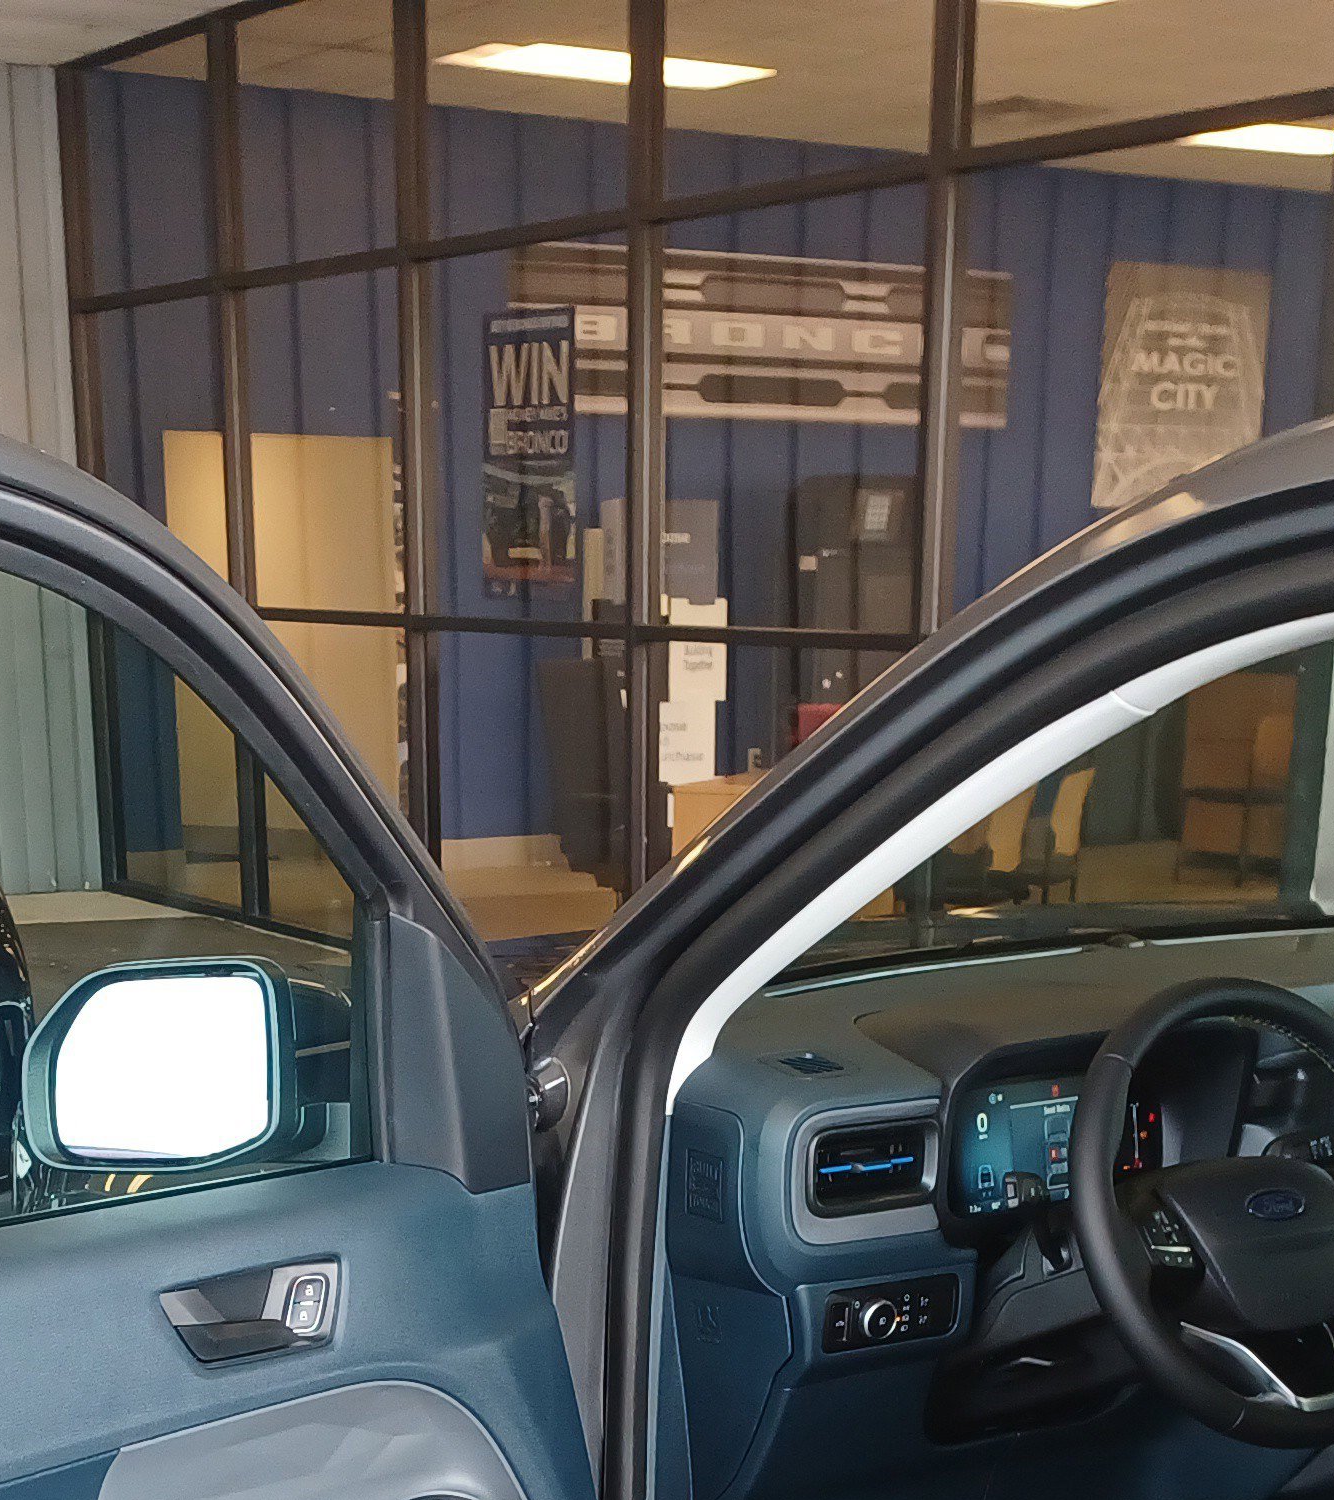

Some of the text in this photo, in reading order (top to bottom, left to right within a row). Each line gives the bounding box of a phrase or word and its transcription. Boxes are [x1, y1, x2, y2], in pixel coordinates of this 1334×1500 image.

[576, 312, 905, 357] BRONC
[489, 339, 570, 407] WIN
[1131, 350, 1237, 378] MAGIC
[1150, 380, 1219, 411] CITY
[507, 428, 569, 455] BRONCO
